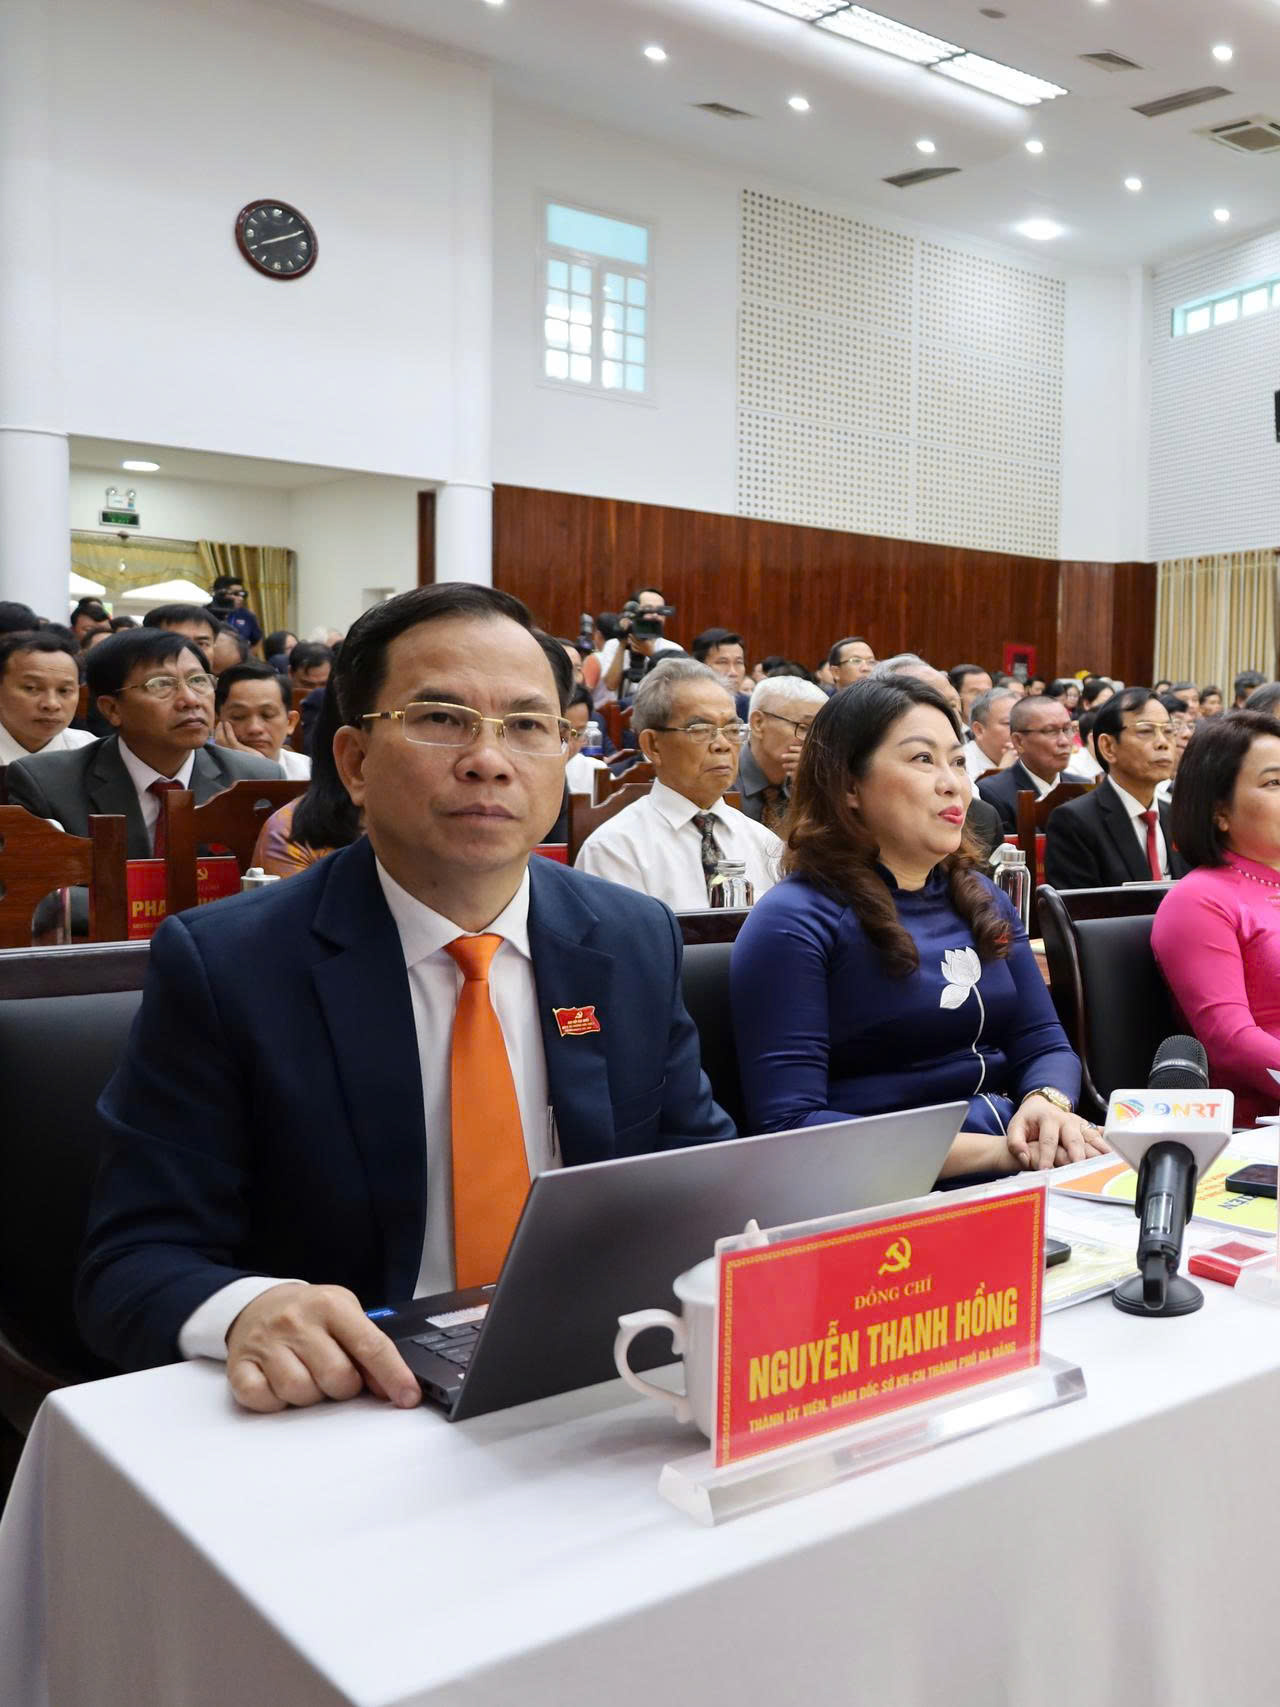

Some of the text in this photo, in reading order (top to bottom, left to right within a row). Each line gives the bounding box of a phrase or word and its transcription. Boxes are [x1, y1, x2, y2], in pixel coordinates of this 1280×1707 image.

[854, 1273, 933, 1310] ĐỒNG CHÍ
[749, 1281, 1018, 1403] NGUYỄN THANH HỒNG
